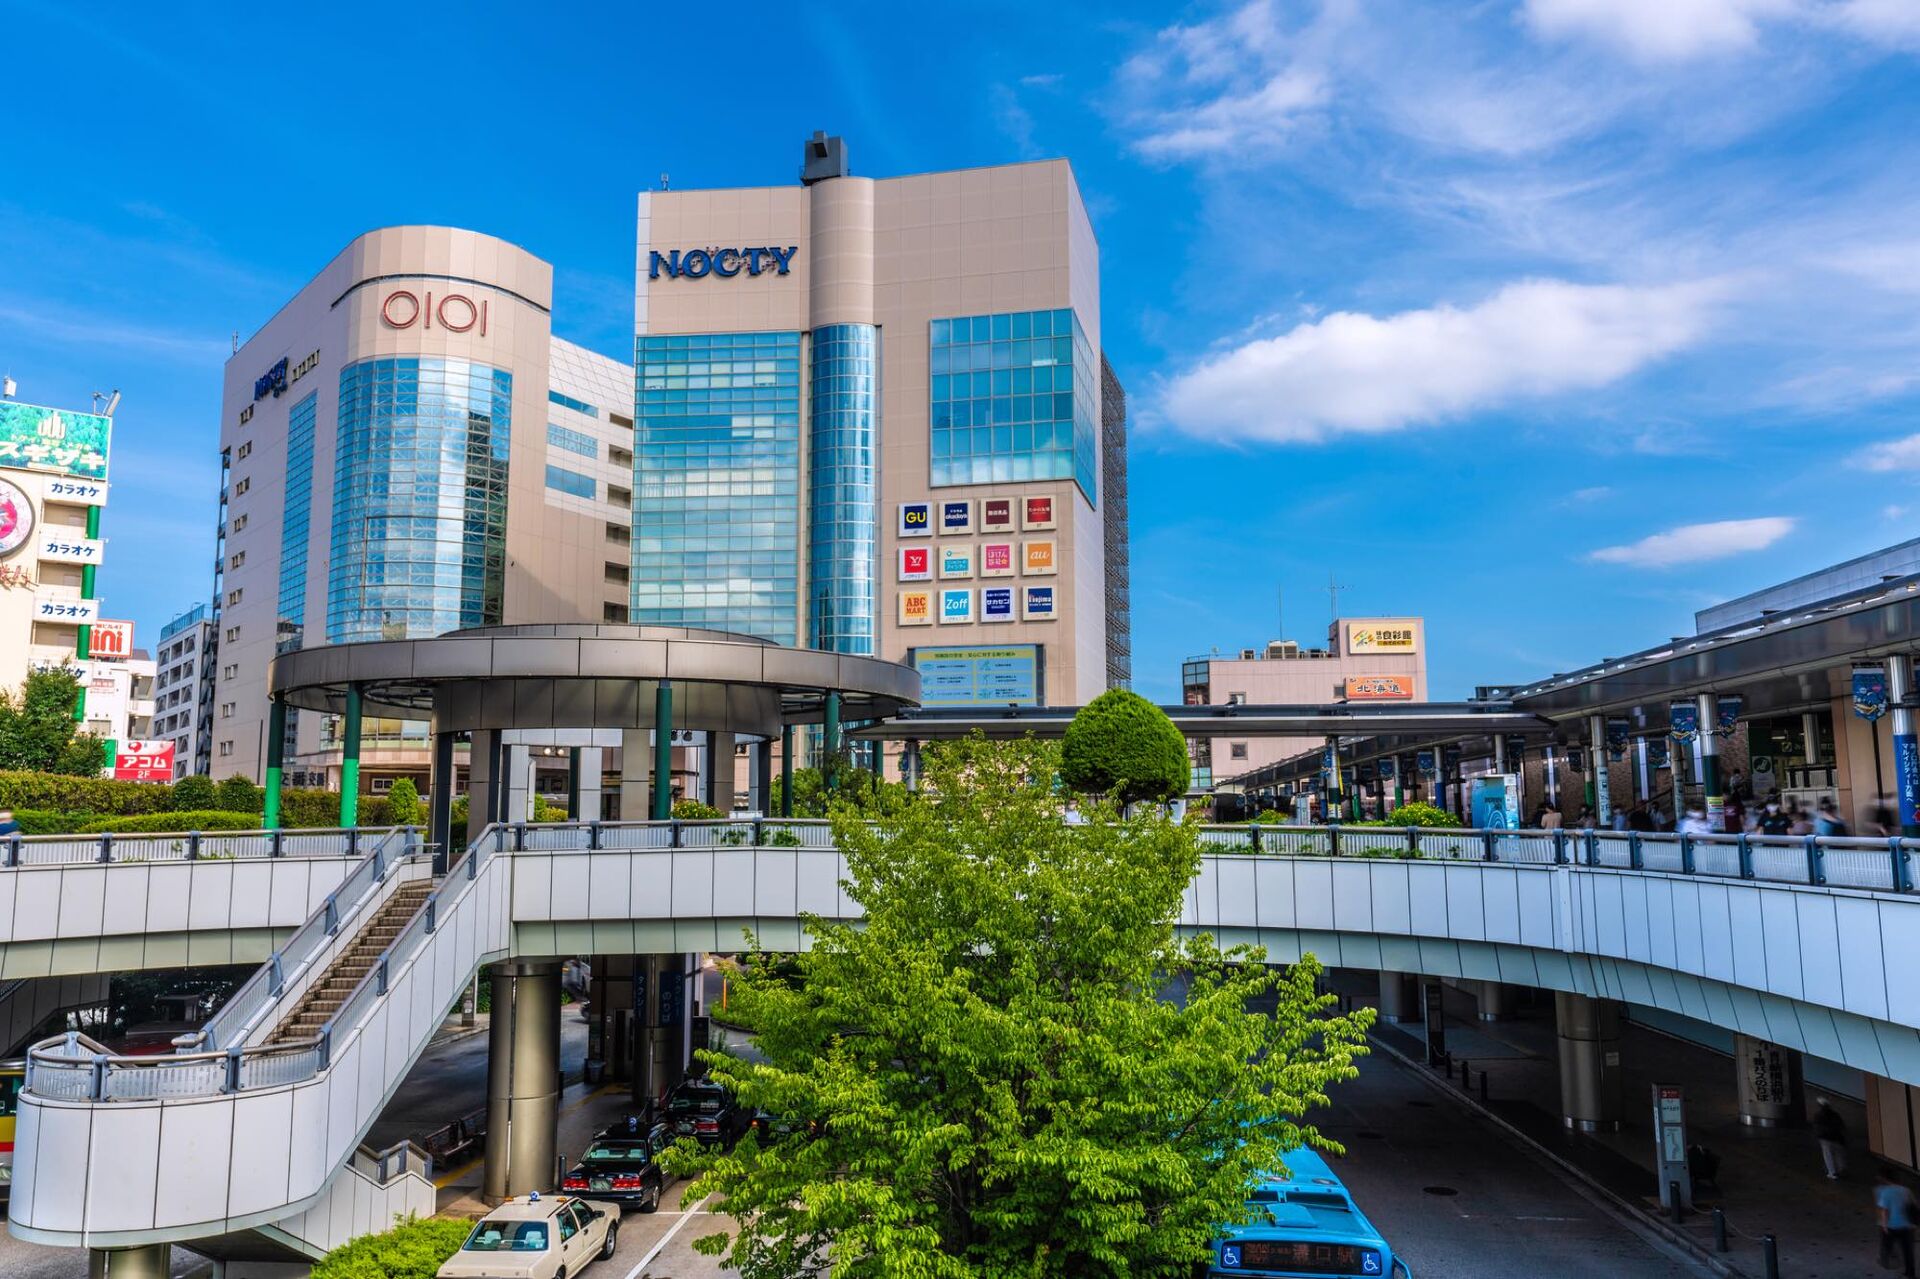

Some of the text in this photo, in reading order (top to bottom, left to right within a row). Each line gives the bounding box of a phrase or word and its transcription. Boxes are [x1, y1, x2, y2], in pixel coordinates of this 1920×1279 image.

[649, 246, 799, 279] NOCTY
[52, 483, 100, 497] カラオケ
[906, 511, 927, 524] GU
[47, 543, 96, 556] カラオケ
[1031, 551, 1050, 560] au
[906, 597, 926, 607] ABC
[946, 598, 968, 610] Zoff
[41, 604, 91, 617] カラオケ
[1357, 684, 1402, 694] 北海道
[123, 756, 167, 768] アコム
[137, 770, 151, 779] 2F
